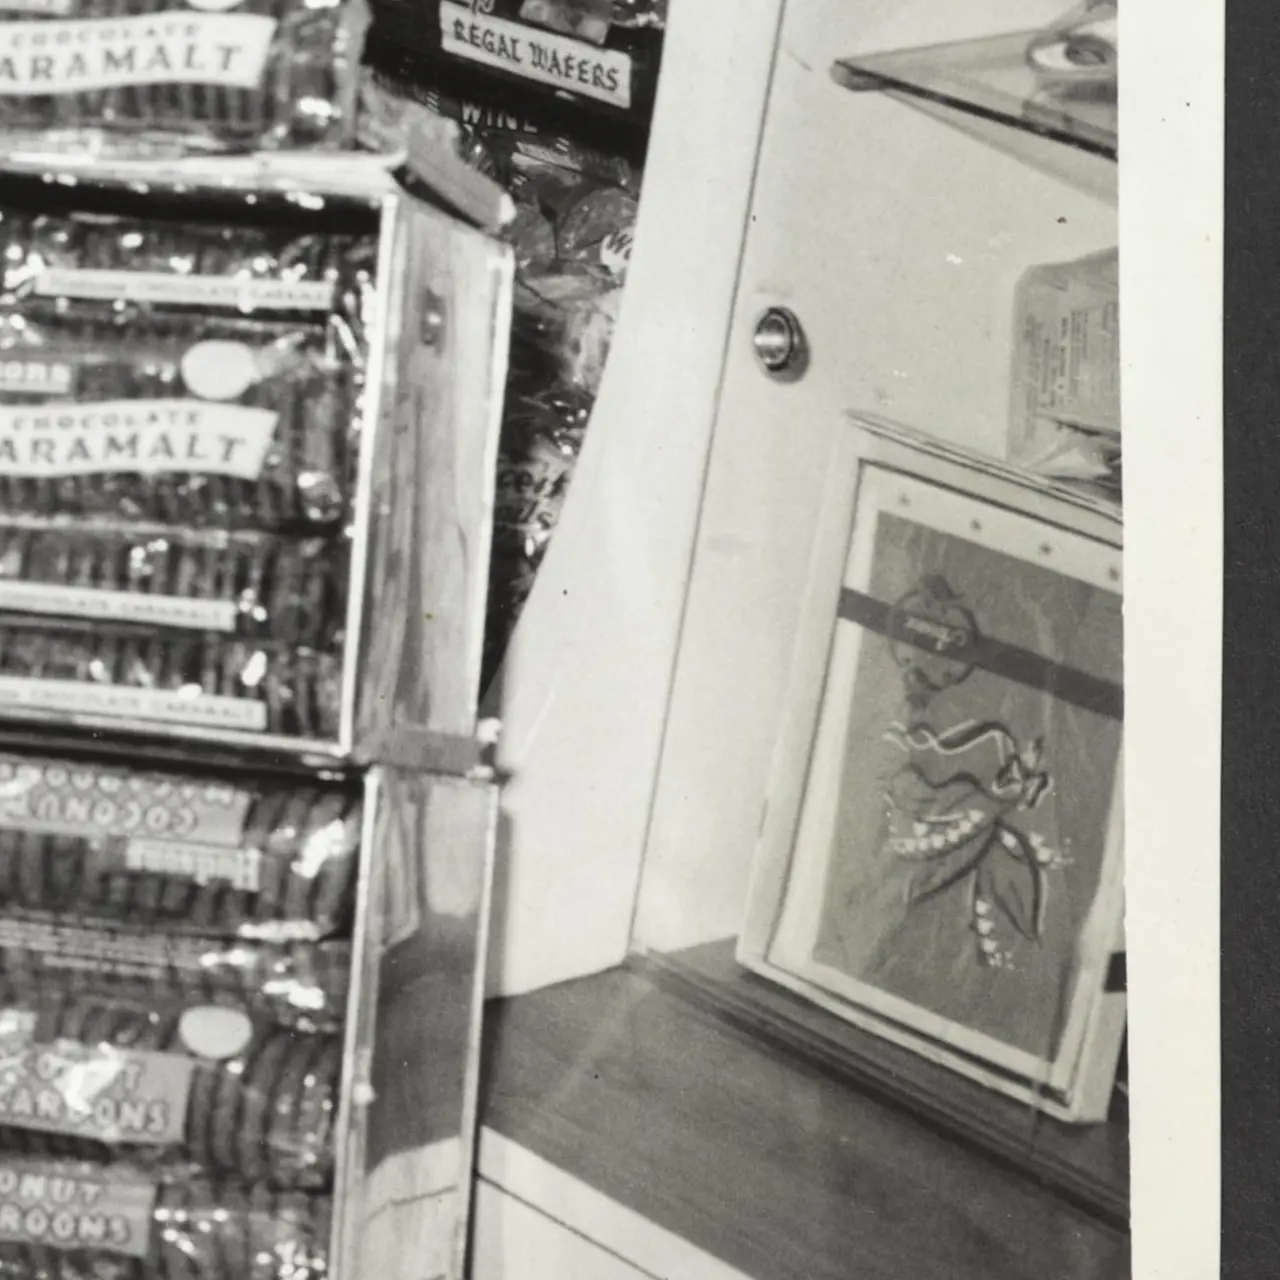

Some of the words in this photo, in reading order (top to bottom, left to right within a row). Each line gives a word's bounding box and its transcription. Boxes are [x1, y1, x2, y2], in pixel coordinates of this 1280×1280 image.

[10, 21, 200, 48] CHOCOLATE
[451, 18, 523, 65] REGAL
[527, 40, 619, 92] WAFERS
[11, 409, 201, 431] CHOCOLATE
